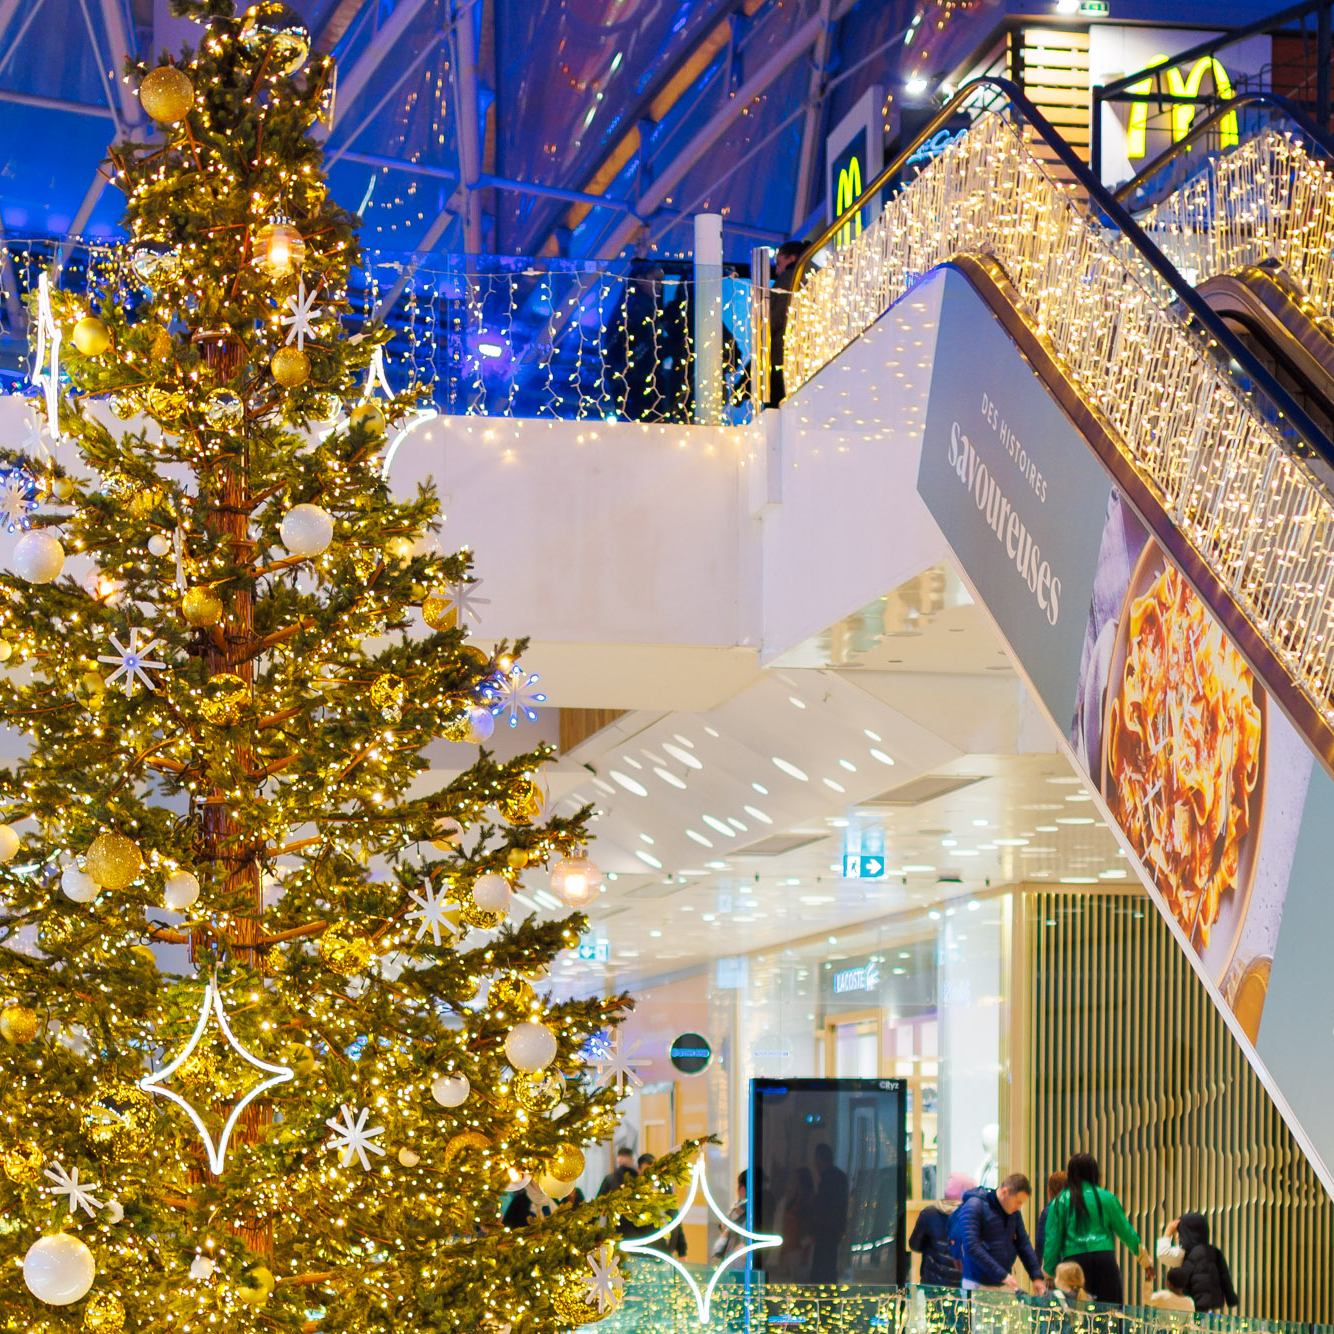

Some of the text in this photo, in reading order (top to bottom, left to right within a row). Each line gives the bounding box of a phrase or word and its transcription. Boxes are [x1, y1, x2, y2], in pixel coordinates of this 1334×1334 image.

[981, 392, 1048, 504] DES HISTOIRES
[948, 421, 1062, 626] savoureuses
[834, 967, 866, 993] LACOSTE
